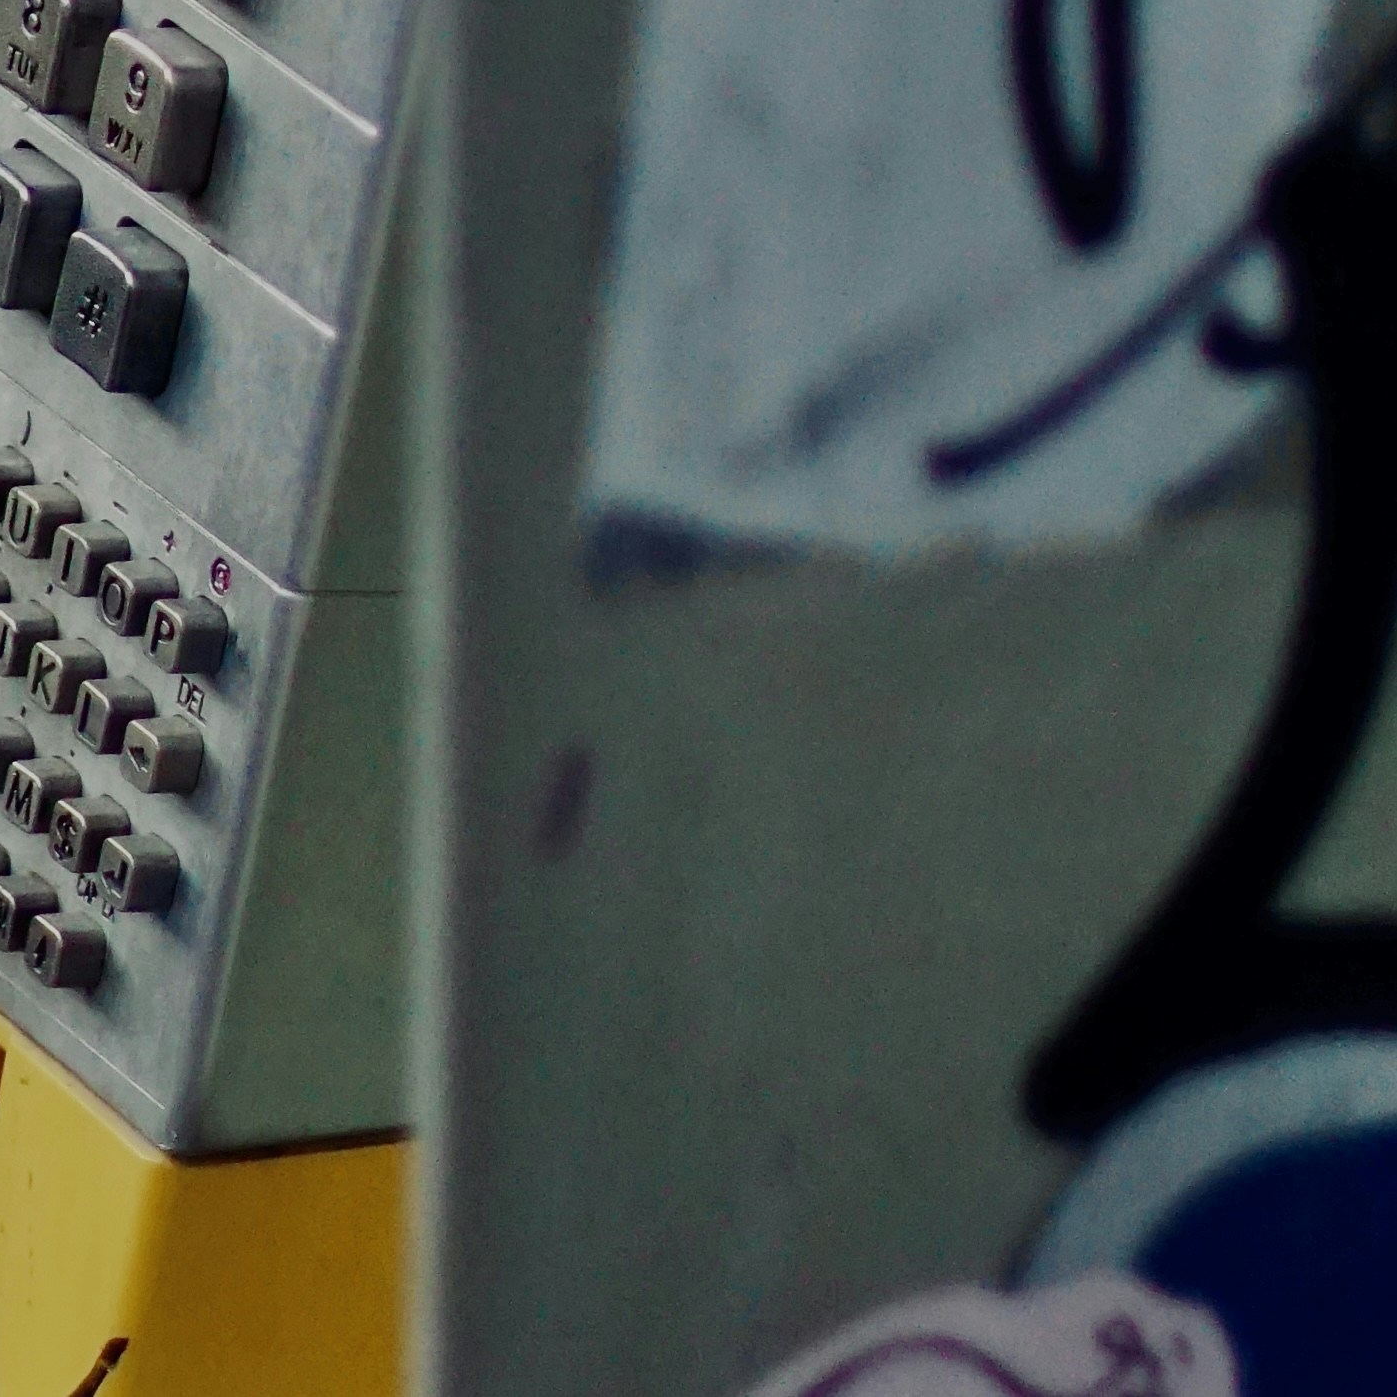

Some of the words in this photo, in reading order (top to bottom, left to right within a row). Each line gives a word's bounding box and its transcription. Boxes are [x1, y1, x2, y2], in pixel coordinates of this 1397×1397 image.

[7, 43, 40, 86] TUV
[125, 63, 149, 115] 9
[8, 494, 34, 549] U
[101, 575, 127, 625] O
[149, 609, 176, 657] P
[177, 674, 206, 722] DEL
[5, 769, 34, 827] M
